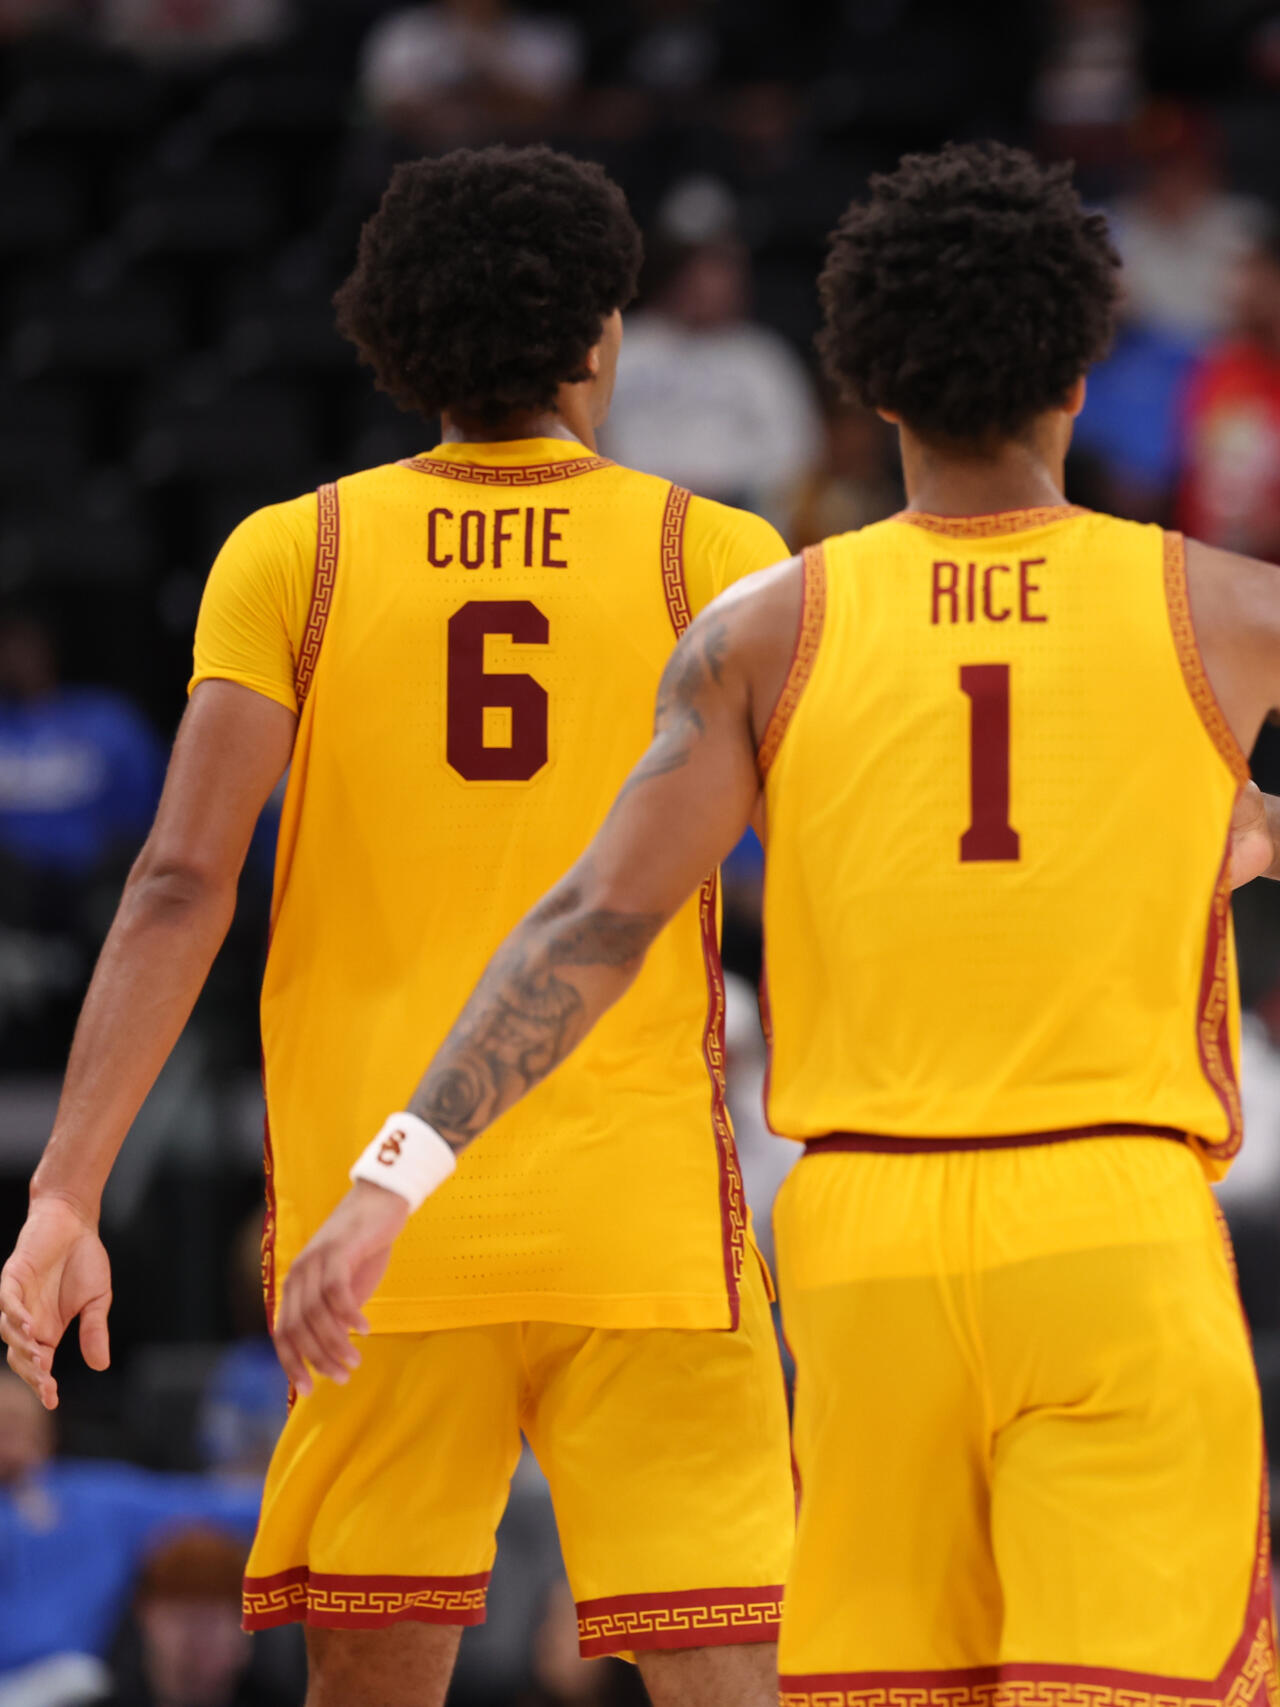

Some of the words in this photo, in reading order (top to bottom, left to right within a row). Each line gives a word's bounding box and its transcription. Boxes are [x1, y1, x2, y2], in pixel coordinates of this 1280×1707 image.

[427, 506, 570, 570] COFIE
[930, 557, 1048, 625] RICE
[446, 600, 549, 781] 6
[959, 662, 1020, 863] 1
